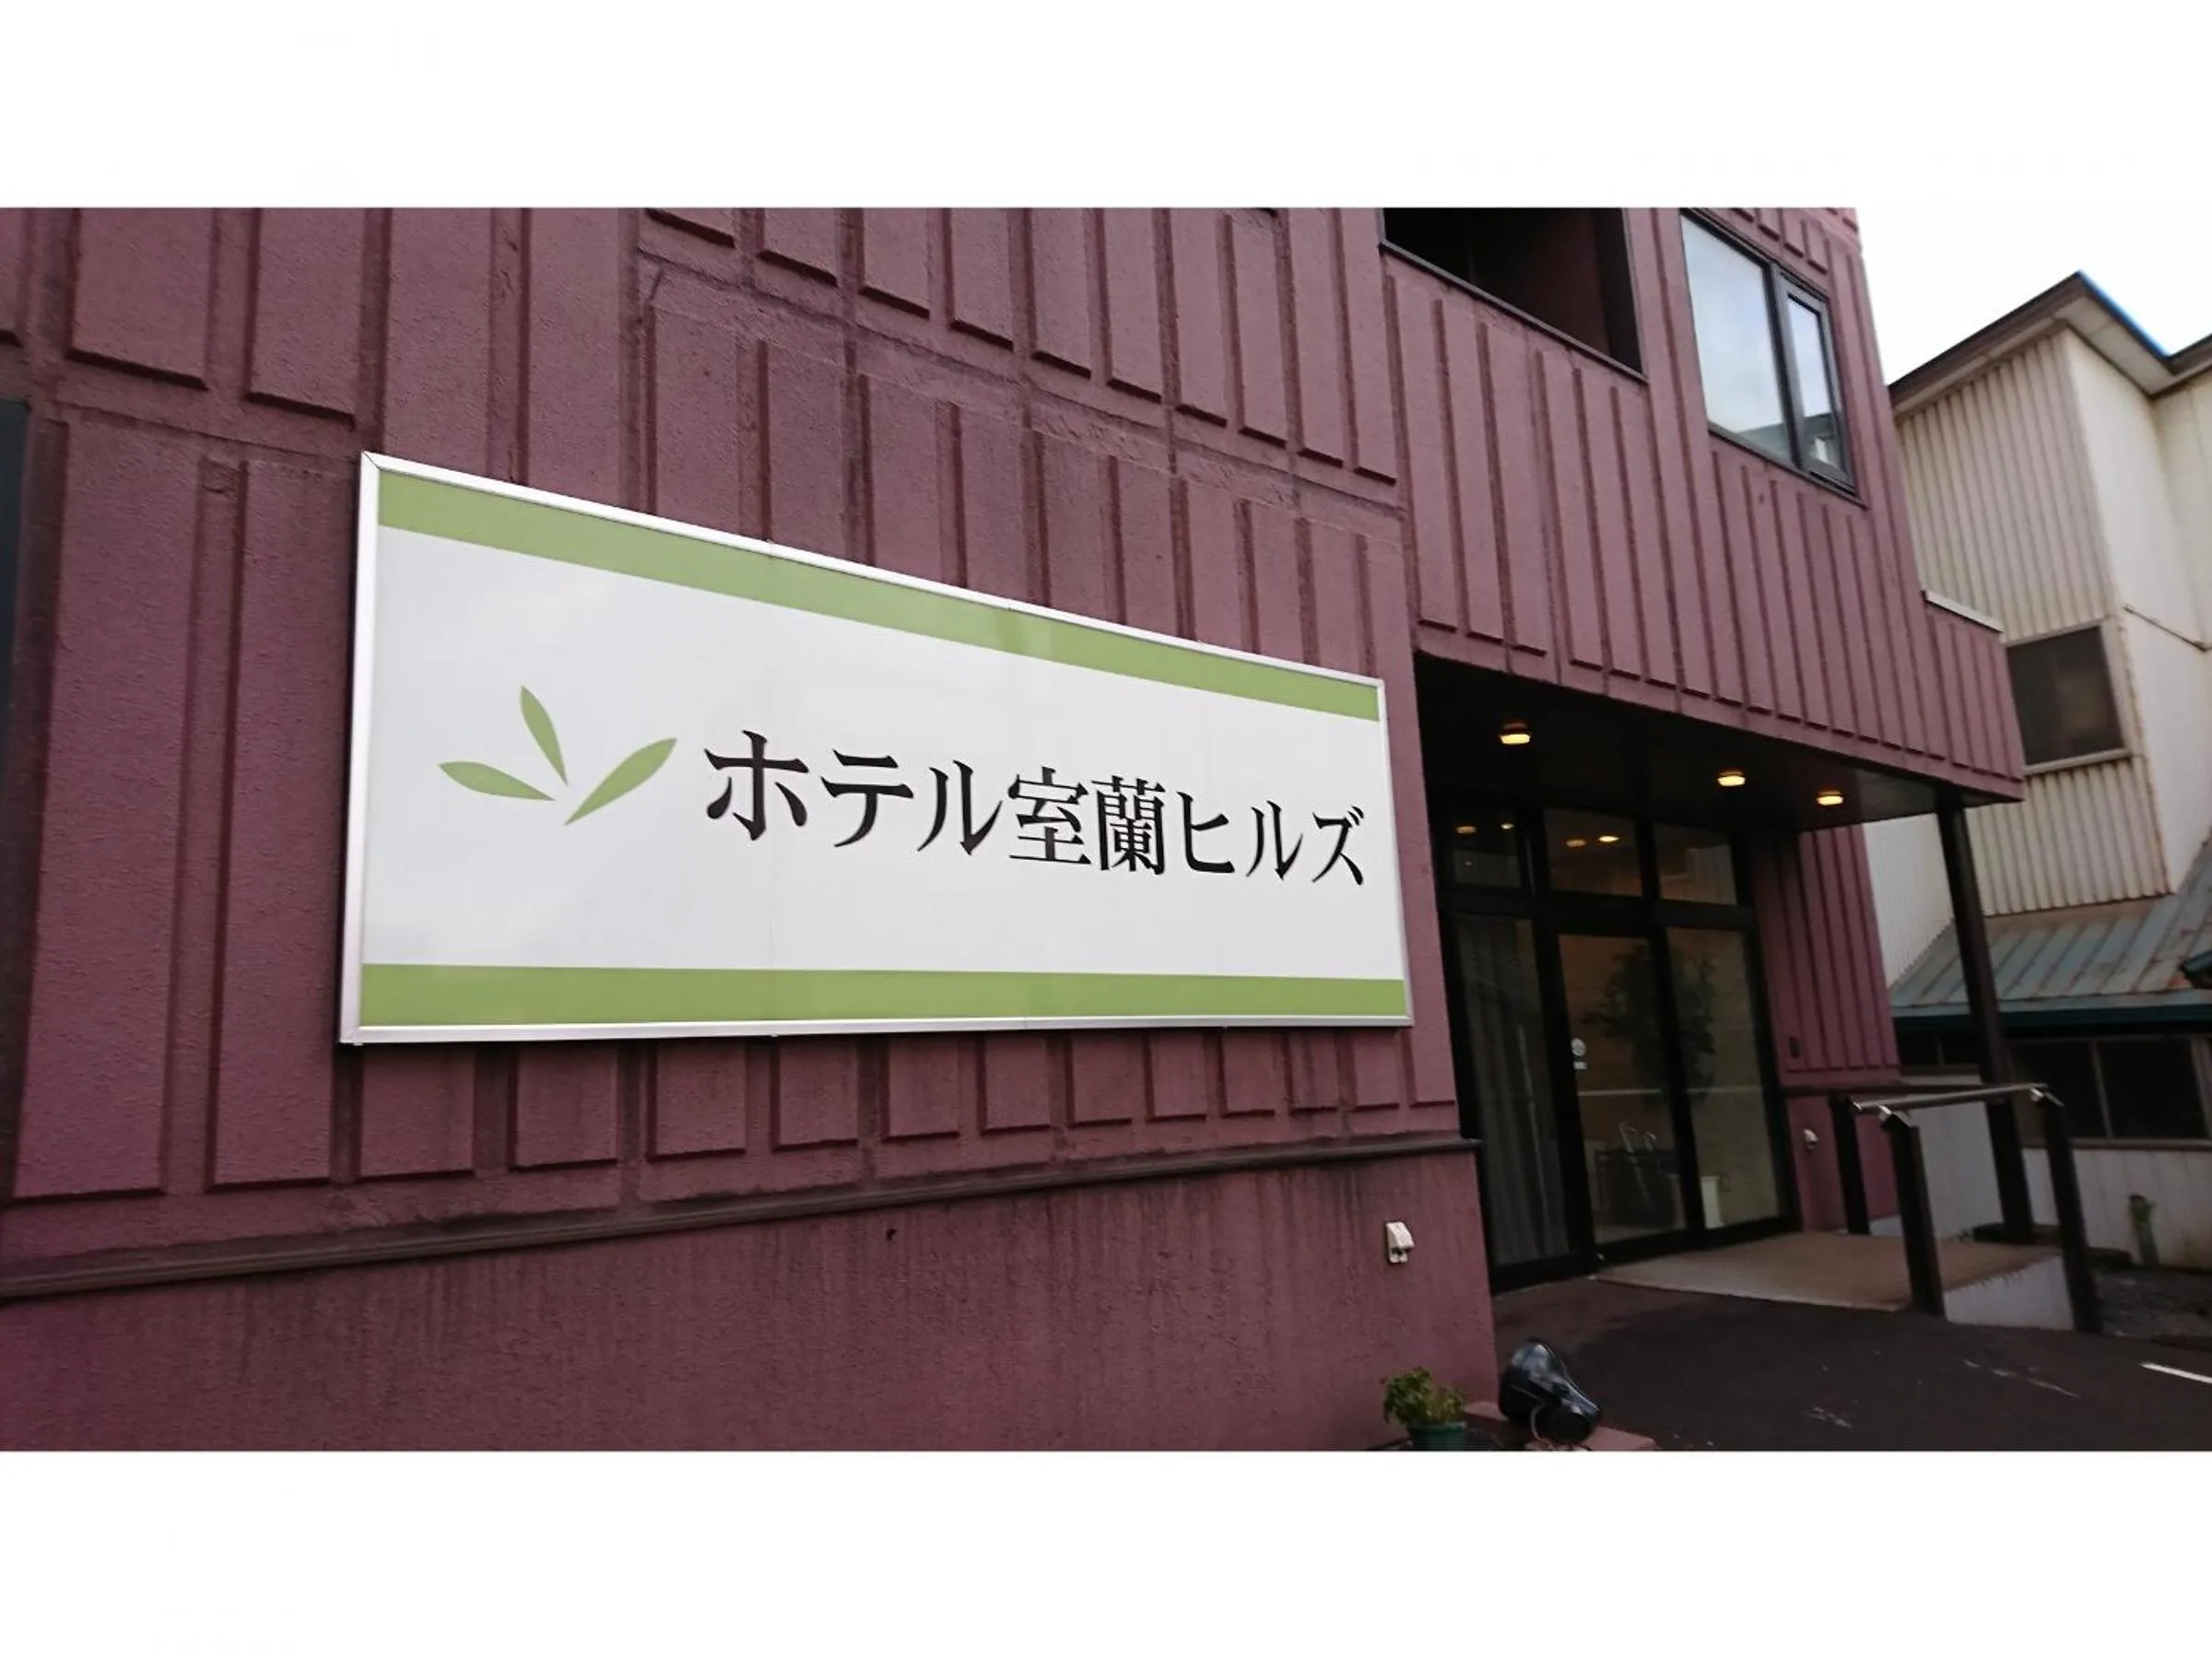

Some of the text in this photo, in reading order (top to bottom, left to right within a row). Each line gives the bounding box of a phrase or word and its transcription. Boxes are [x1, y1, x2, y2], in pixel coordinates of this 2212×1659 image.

[703, 729, 1365, 886] ホテル室蘭ヒルズ
